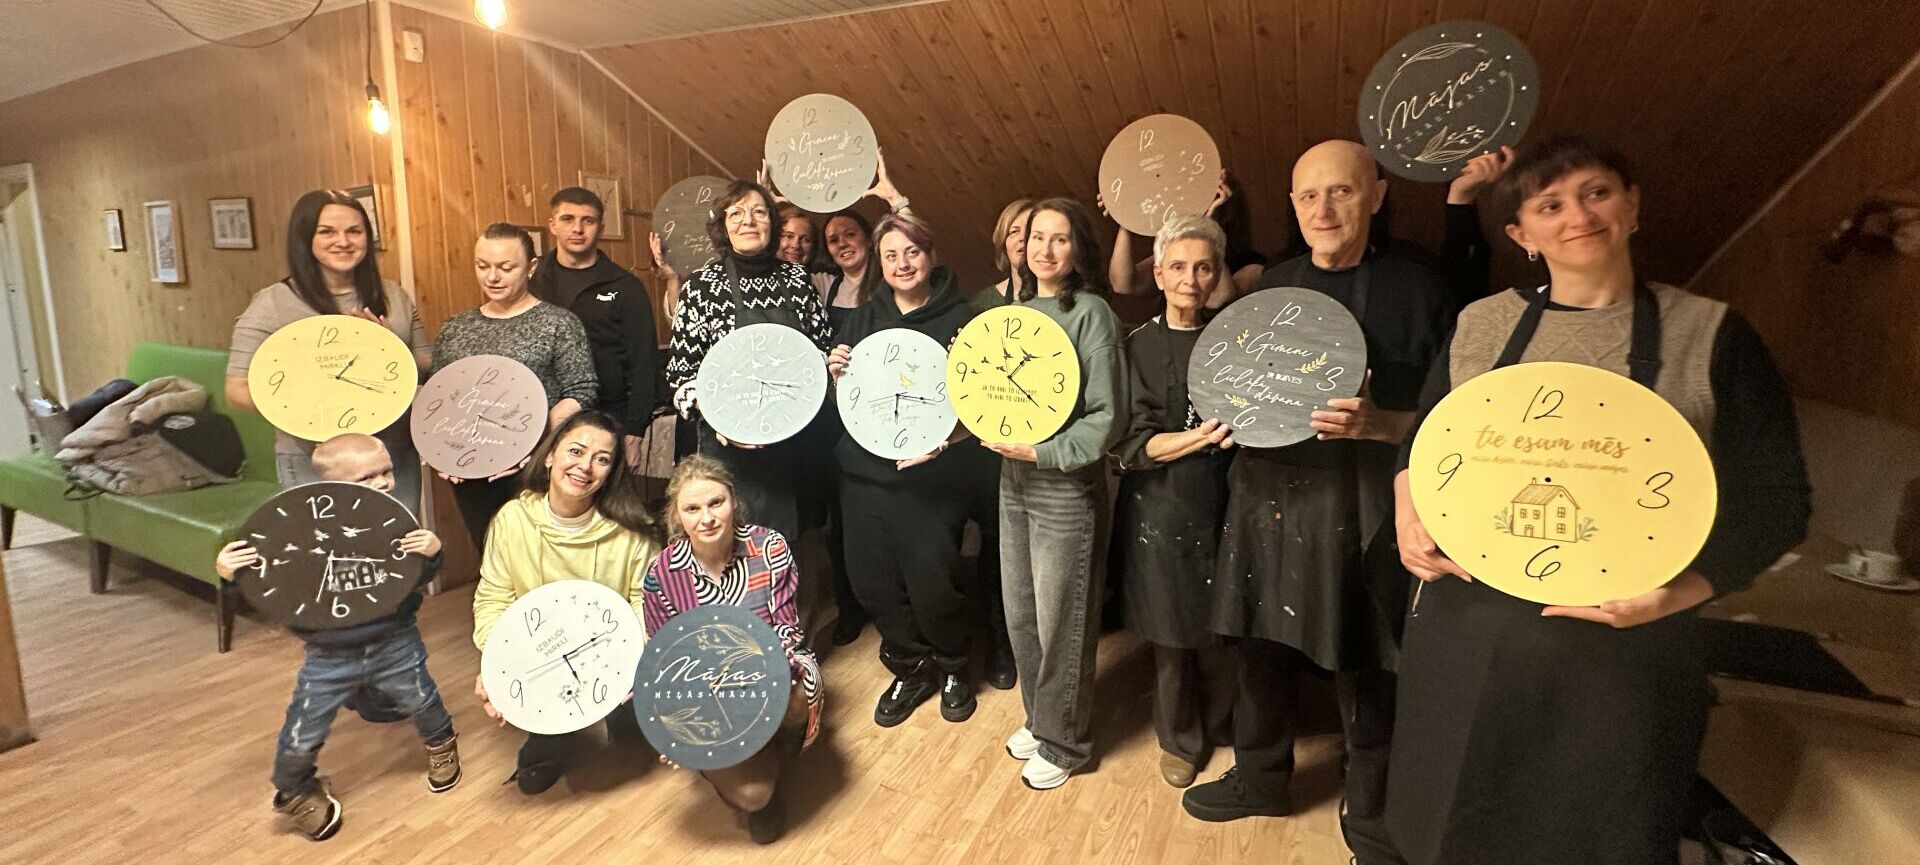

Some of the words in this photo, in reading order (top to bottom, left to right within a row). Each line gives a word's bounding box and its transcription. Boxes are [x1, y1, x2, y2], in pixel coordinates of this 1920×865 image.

[803, 108, 817, 129] 12
[852, 135, 865, 155] 3
[1139, 129, 1155, 152] 12
[777, 152, 788, 173] 9
[1191, 152, 1205, 174] 3
[696, 186, 713, 205] 12
[825, 183, 838, 203] 6
[1111, 178, 1122, 202] 9
[1162, 203, 1177, 224] 6
[664, 220, 675, 241] 9
[1270, 301, 1301, 327] 12
[318, 326, 340, 348] 12
[1003, 317, 1022, 339] 12
[751, 332, 767, 352] 12
[883, 343, 900, 365] 12
[1204, 341, 1228, 367] 9
[384, 361, 399, 381] 3
[475, 367, 499, 386] 12
[803, 367, 815, 386] 3
[955, 362, 967, 382] 9
[1316, 366, 1344, 391] 3
[269, 370, 285, 396] 9
[705, 379, 718, 399] 9
[936, 381, 946, 402] 3
[1052, 372, 1065, 394] 3
[424, 399, 443, 420] 9
[850, 387, 861, 411] 9
[1522, 385, 1565, 423] 12
[338, 408, 357, 429] 6
[516, 413, 532, 432] 3
[760, 415, 772, 435] 6
[1000, 415, 1012, 437] 6
[1232, 405, 1260, 429] 6
[894, 428, 908, 449] 6
[1475, 425, 1506, 449] tie
[1514, 434, 1575, 453] esam
[1581, 436, 1631, 459] mēs
[456, 449, 477, 468] 6
[1437, 453, 1463, 491] 9
[1637, 471, 1674, 509] 3
[306, 494, 335, 519] 12
[390, 538, 407, 561] 3
[250, 555, 267, 579] 9
[1524, 544, 1562, 582] 6
[331, 596, 350, 618] 6
[524, 607, 547, 637] 12
[602, 609, 619, 634] 3
[655, 656, 767, 695] Mājas
[510, 679, 524, 707] 9
[592, 678, 608, 704] 6
